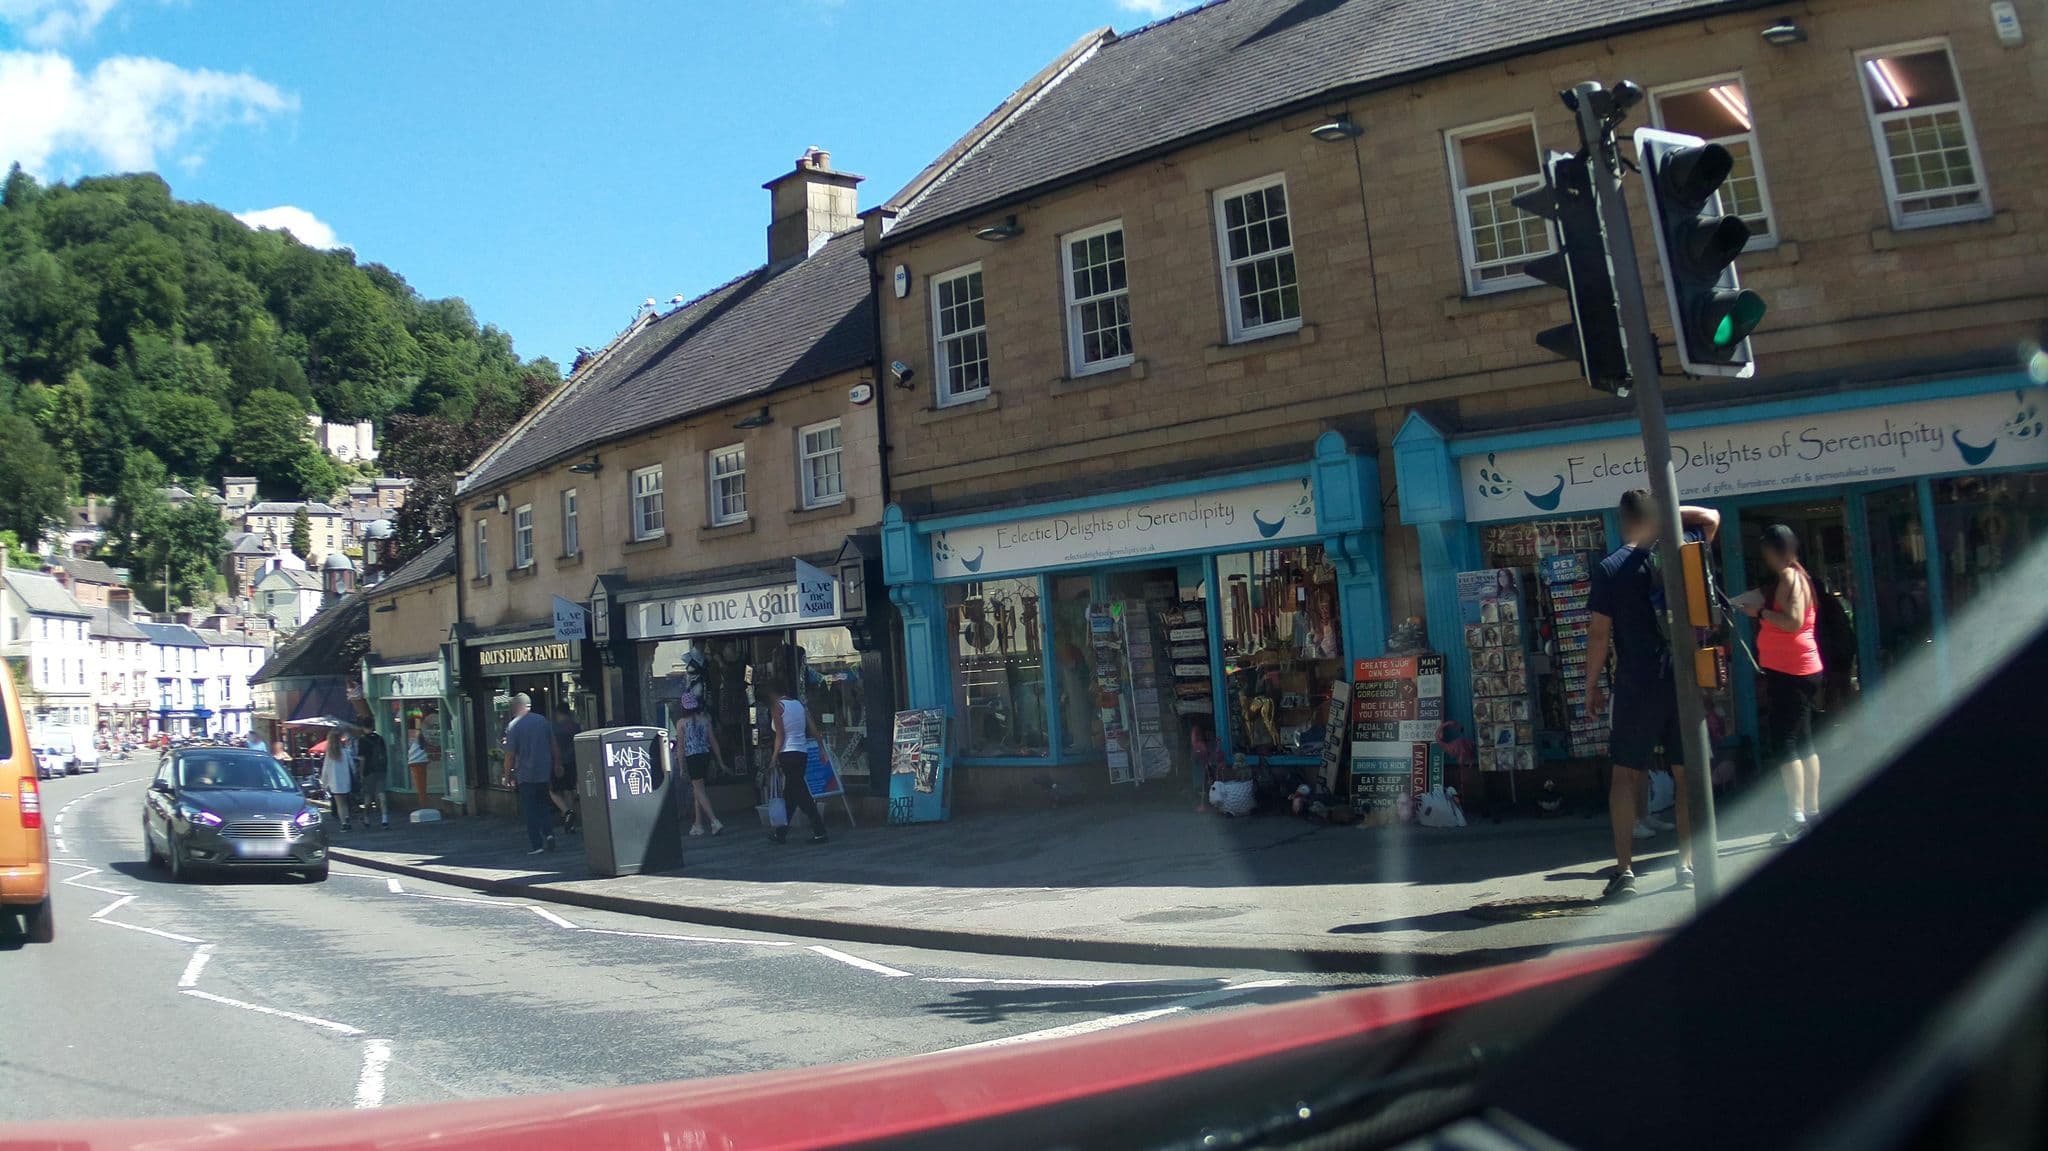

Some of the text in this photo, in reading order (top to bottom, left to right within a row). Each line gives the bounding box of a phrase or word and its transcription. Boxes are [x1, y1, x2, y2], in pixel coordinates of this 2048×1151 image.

[1567, 453, 1650, 485] Eclecti
[1768, 432, 1791, 459] of
[1797, 419, 1945, 461] Serendipity
[1702, 483, 1711, 493] of
[1804, 472, 1813, 482] &
[995, 499, 1236, 549] Eclectic Delights of Serendipity
[1553, 559, 1575, 570] PET
[810, 593, 825, 601] me
[707, 598, 738, 622] me
[803, 600, 833, 613] Again
[506, 646, 533, 663] FUDGE
[534, 643, 569, 661] PANTRY
[1360, 660, 1409, 671] CREATE YOUR
[1384, 669, 1401, 677] SIGN
[1418, 668, 1439, 676] CAVE
[1355, 682, 1381, 691] GRUMPY
[1384, 681, 1399, 689] BUT
[1360, 702, 1377, 710] RIDE
[1388, 701, 1405, 709] LIKE
[1421, 700, 1438, 708] BIKE
[1374, 710, 1398, 718] STOLE
[1419, 709, 1439, 717] SHED
[1358, 722, 1394, 731] PEDAL TO
[1356, 732, 1371, 740] THE
[1372, 731, 1395, 739] METAL
[1356, 760, 1407, 769] BORN TO RIDE
[1414, 751, 1424, 775] MAN
[1361, 776, 1401, 784] EAT SLEEP
[1357, 784, 1404, 792] BIKE REPEAT
